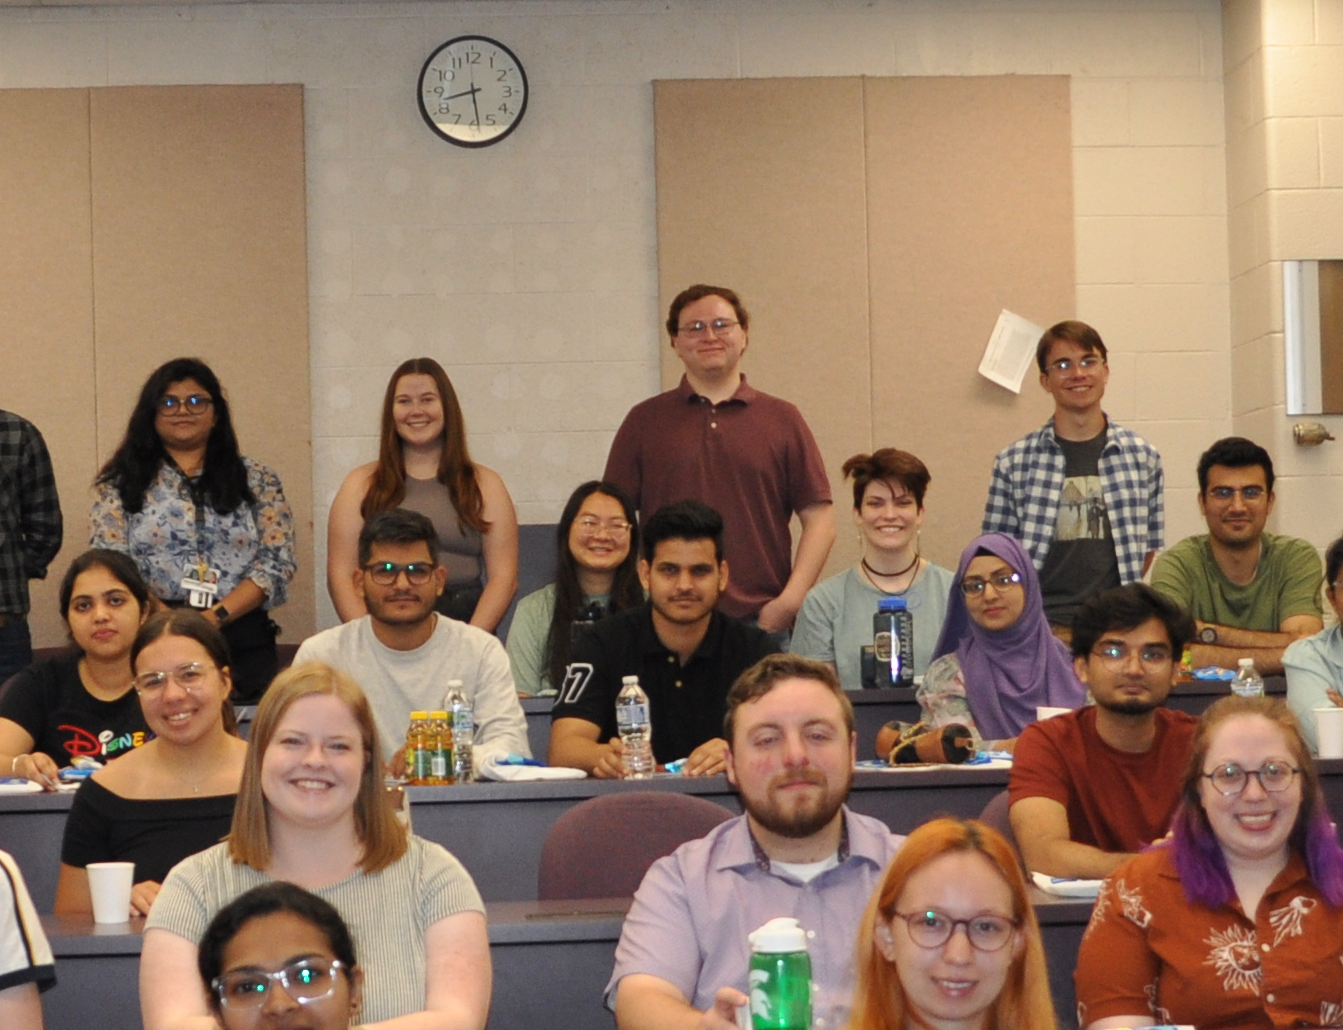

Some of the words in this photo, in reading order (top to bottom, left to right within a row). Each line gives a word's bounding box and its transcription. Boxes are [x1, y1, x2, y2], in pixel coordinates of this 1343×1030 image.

[451, 57, 462, 69] 11
[465, 52, 481, 64] 12
[438, 69, 456, 82] 10
[496, 69, 507, 81] 2
[433, 86, 445, 99] 9
[501, 86, 512, 98] 3
[438, 102, 450, 114] 8
[498, 102, 508, 114] 4
[451, 113, 462, 125] 7
[485, 114, 496, 126] 5
